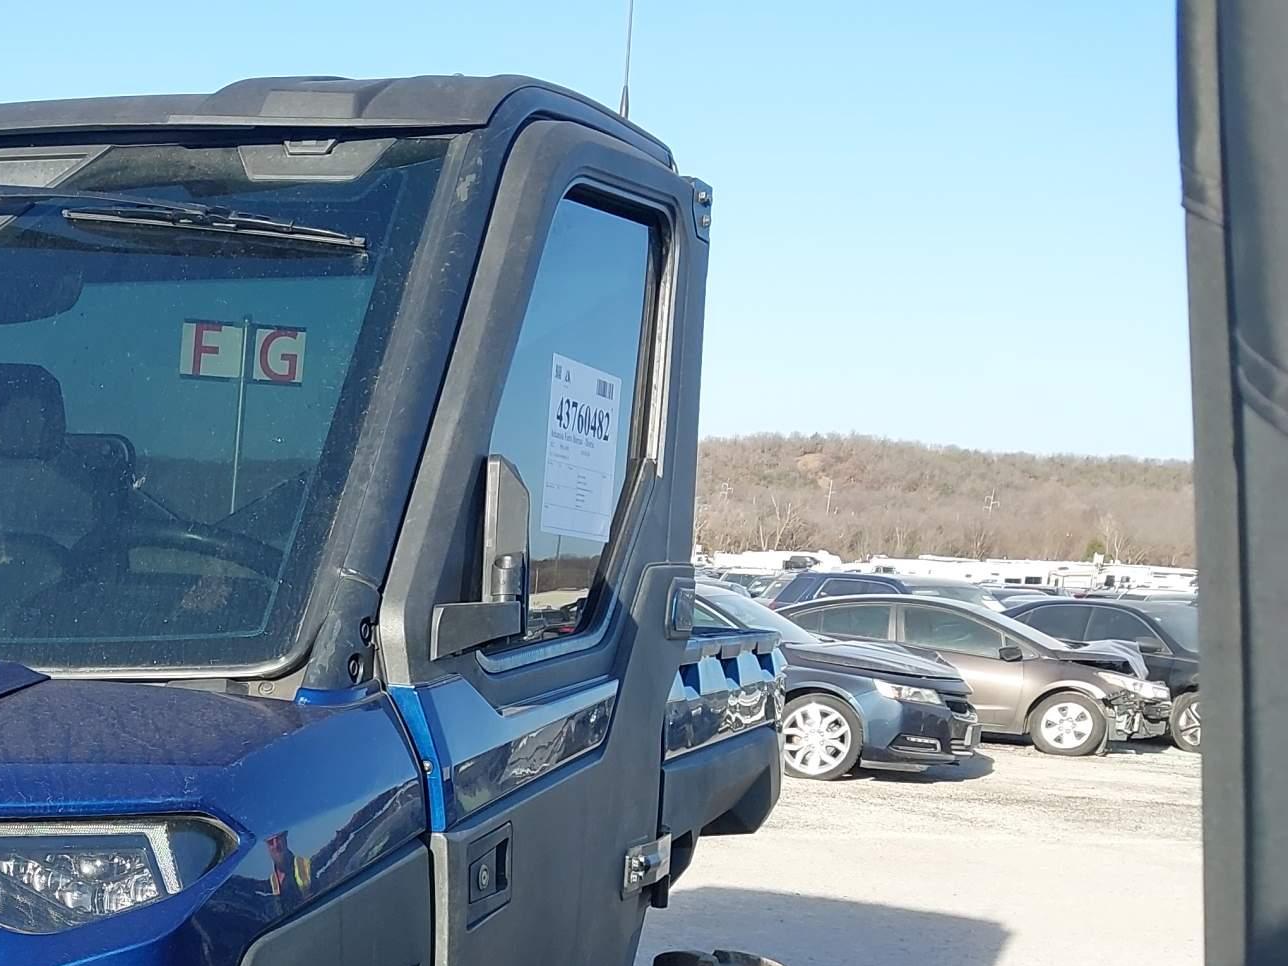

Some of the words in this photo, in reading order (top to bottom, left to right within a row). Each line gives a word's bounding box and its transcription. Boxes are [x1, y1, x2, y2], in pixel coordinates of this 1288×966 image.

[191, 322, 223, 376] F
[259, 328, 298, 384] G
[556, 396, 610, 441] 43760482
